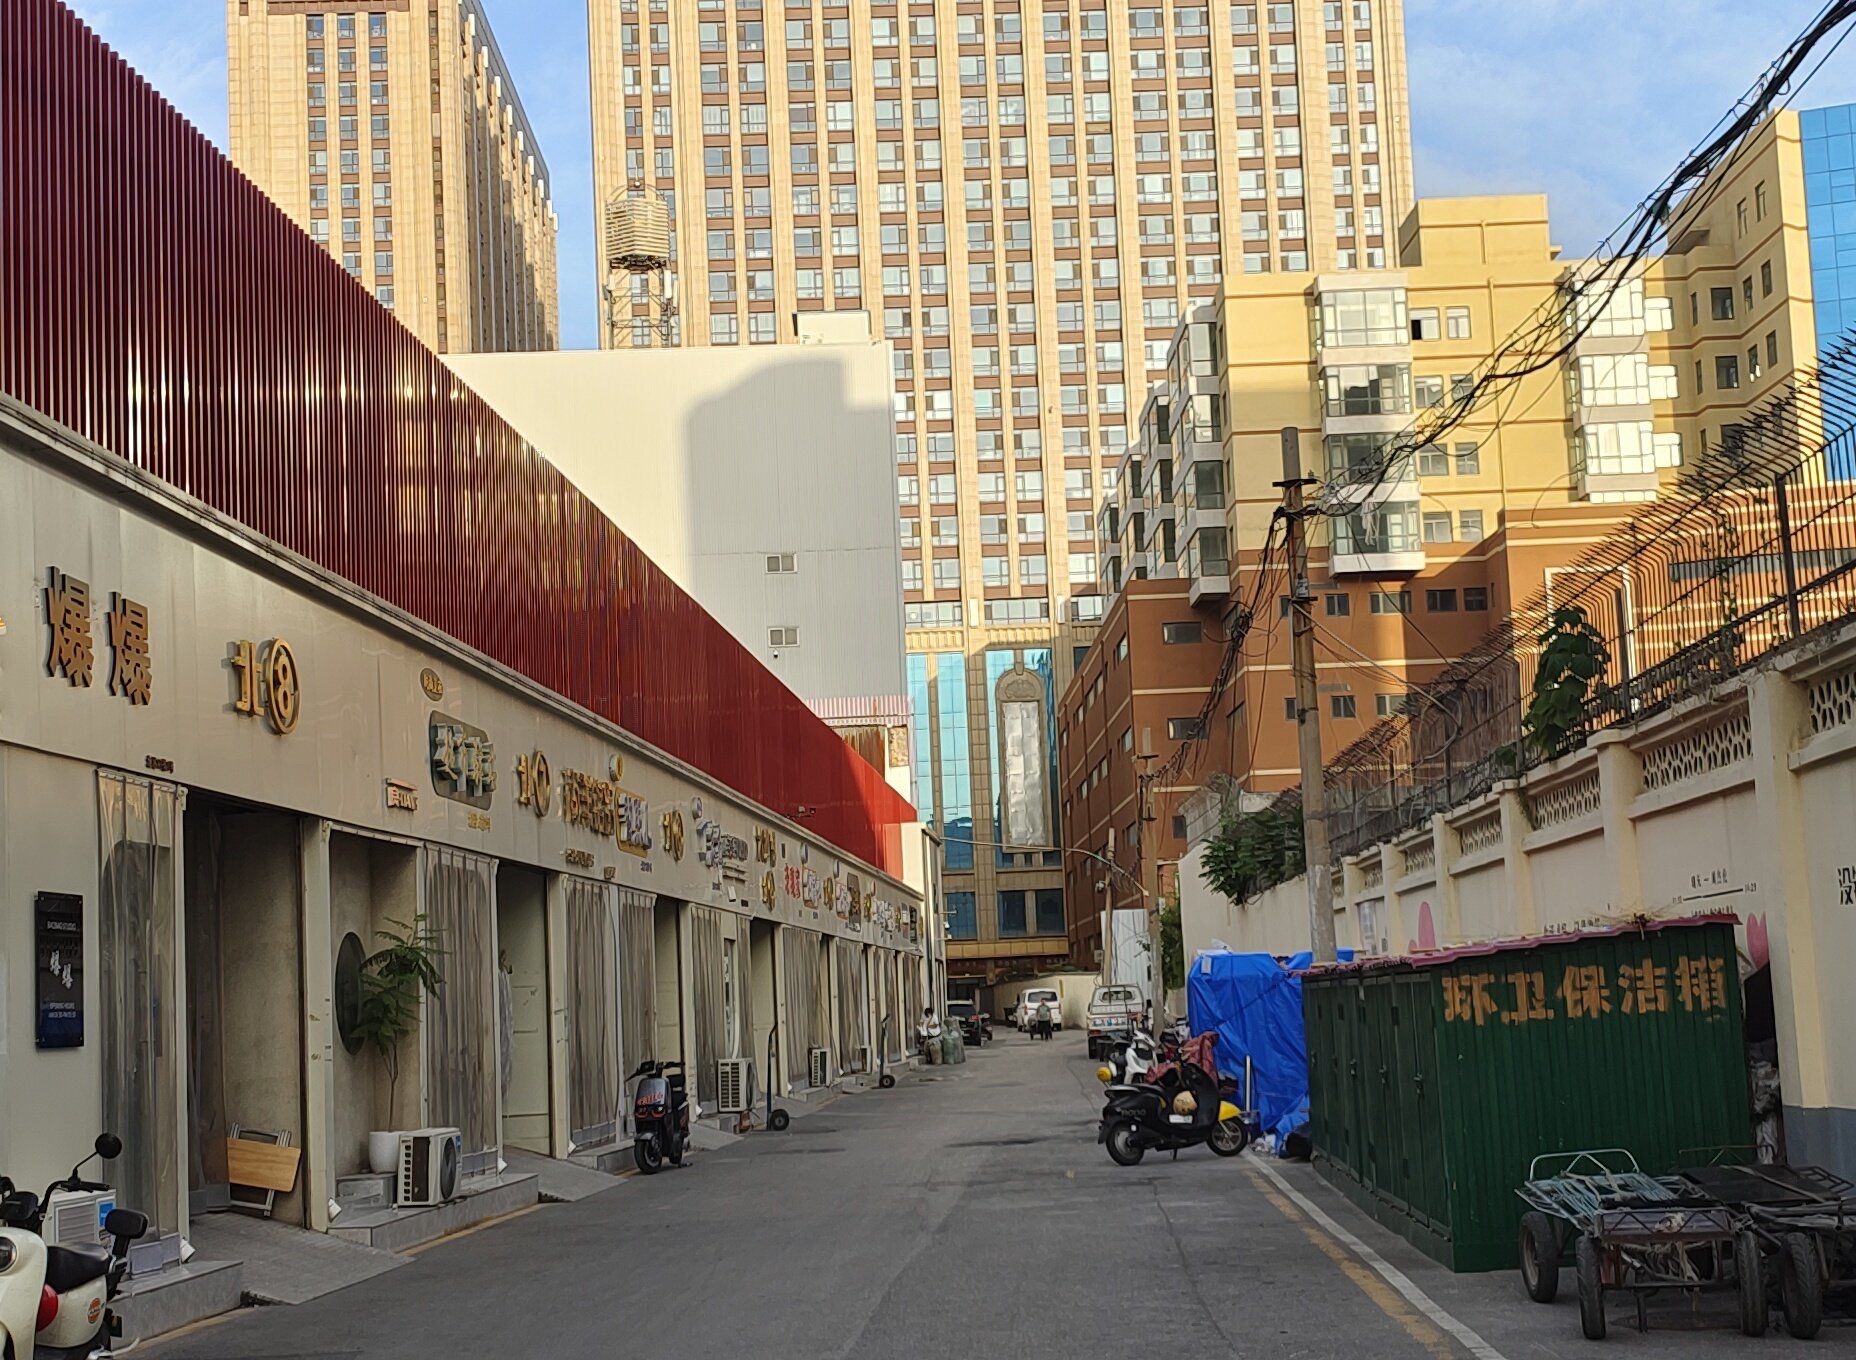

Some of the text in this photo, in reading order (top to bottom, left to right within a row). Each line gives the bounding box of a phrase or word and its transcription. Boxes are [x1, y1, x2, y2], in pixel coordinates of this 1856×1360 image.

[42, 565, 152, 705] 爆爆
[1441, 955, 1726, 1026] 环卫保洁箱
